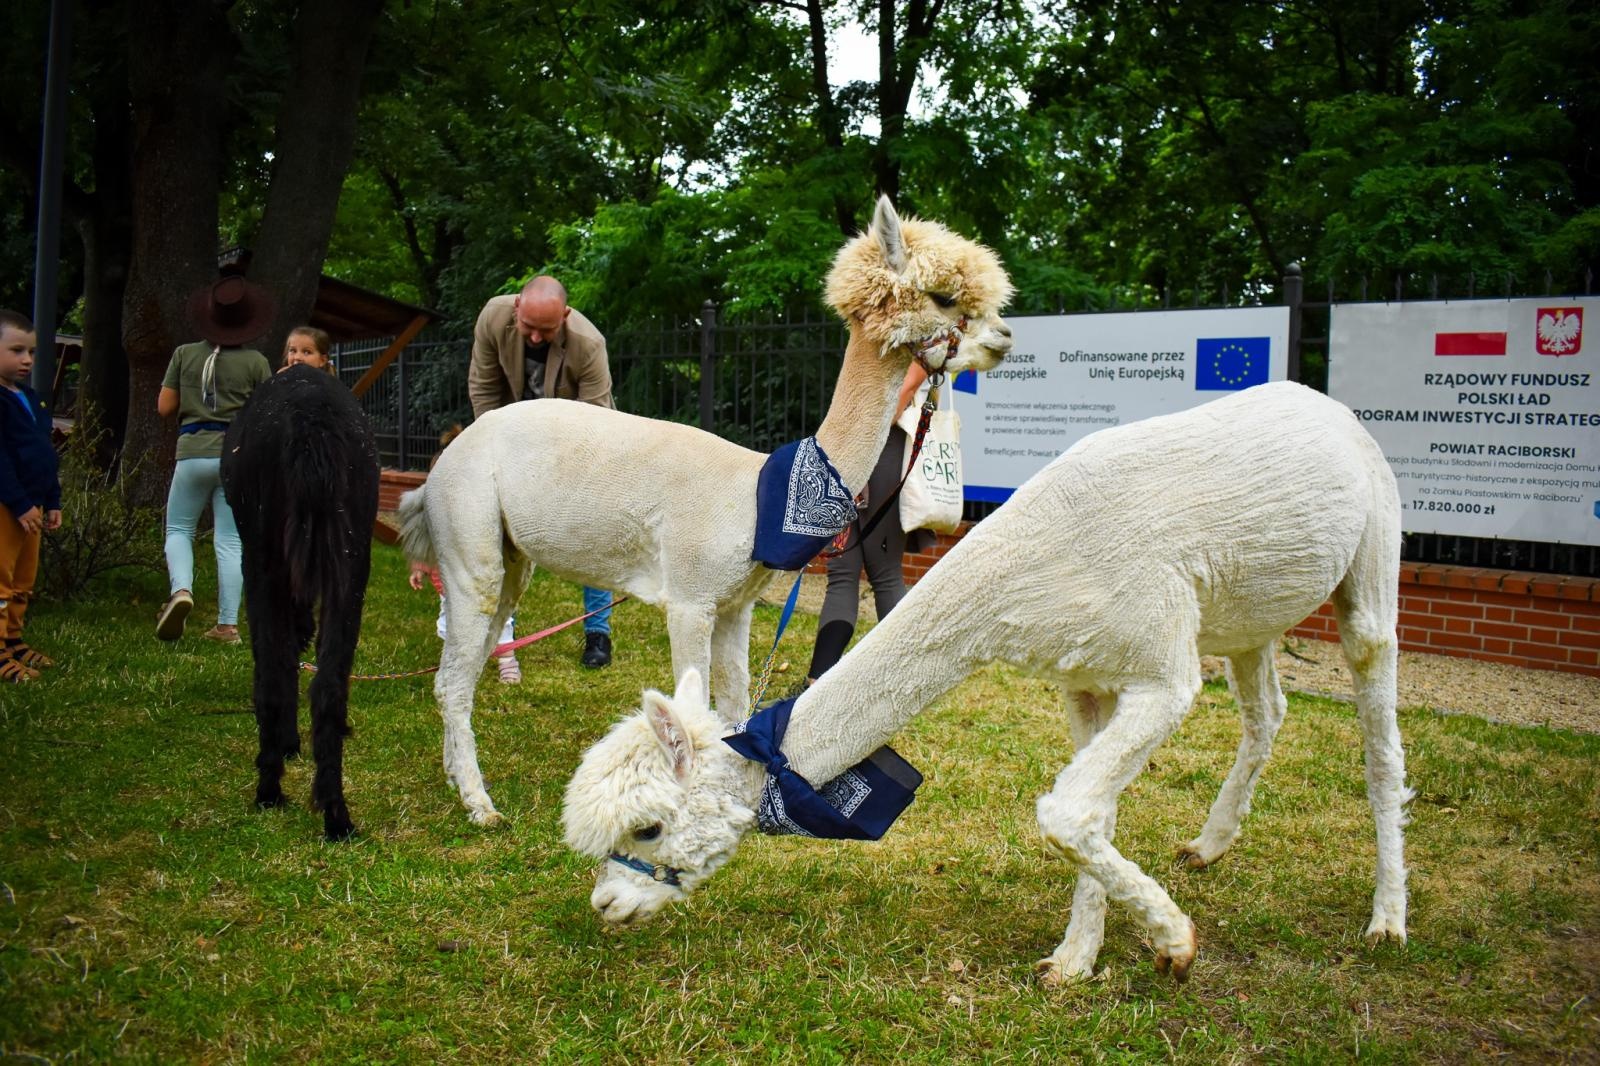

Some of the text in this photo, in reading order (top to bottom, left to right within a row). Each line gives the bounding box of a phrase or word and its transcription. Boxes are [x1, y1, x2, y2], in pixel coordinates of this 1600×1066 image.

[1003, 352, 1035, 364] dusze
[1059, 351, 1185, 364] Dofinansowane przez
[986, 367, 1047, 381] Europejskie
[1089, 366, 1185, 381] Unię Europejską
[1424, 373, 1590, 389] RZĄDOWY FUNDUSZ
[1458, 392, 1550, 406] POLSKI ŁAD
[985, 401, 1031, 410] Wzmocnienie
[1069, 402, 1116, 413] społecznego
[993, 414, 1018, 422] okresie
[1019, 415, 1068, 425] sprawiedliwej
[1069, 415, 1120, 425] transformacji
[1353, 409, 1600, 427] ROGRAM INWESTYCJI STRATEG
[992, 427, 1022, 436] powiecie
[1024, 427, 1066, 436] raciborskim
[1027, 449, 1053, 457] Powiat
[1430, 443, 1576, 458] POWIAT RACIBORSKI
[1386, 456, 1409, 466] tacja
[1411, 456, 1449, 467] budynku
[1451, 458, 1492, 468] Słodowni
[1498, 461, 1563, 473] modernizacja
[1566, 464, 1595, 473] Domu
[1411, 471, 1518, 485] turystyczno-historyczne
[1526, 477, 1579, 489] ekspozycją
[1432, 487, 1463, 497] Zamku
[1464, 488, 1521, 499] Piastowskim
[1413, 500, 1481, 514] 17.820.000
[1484, 504, 1495, 515] zł
